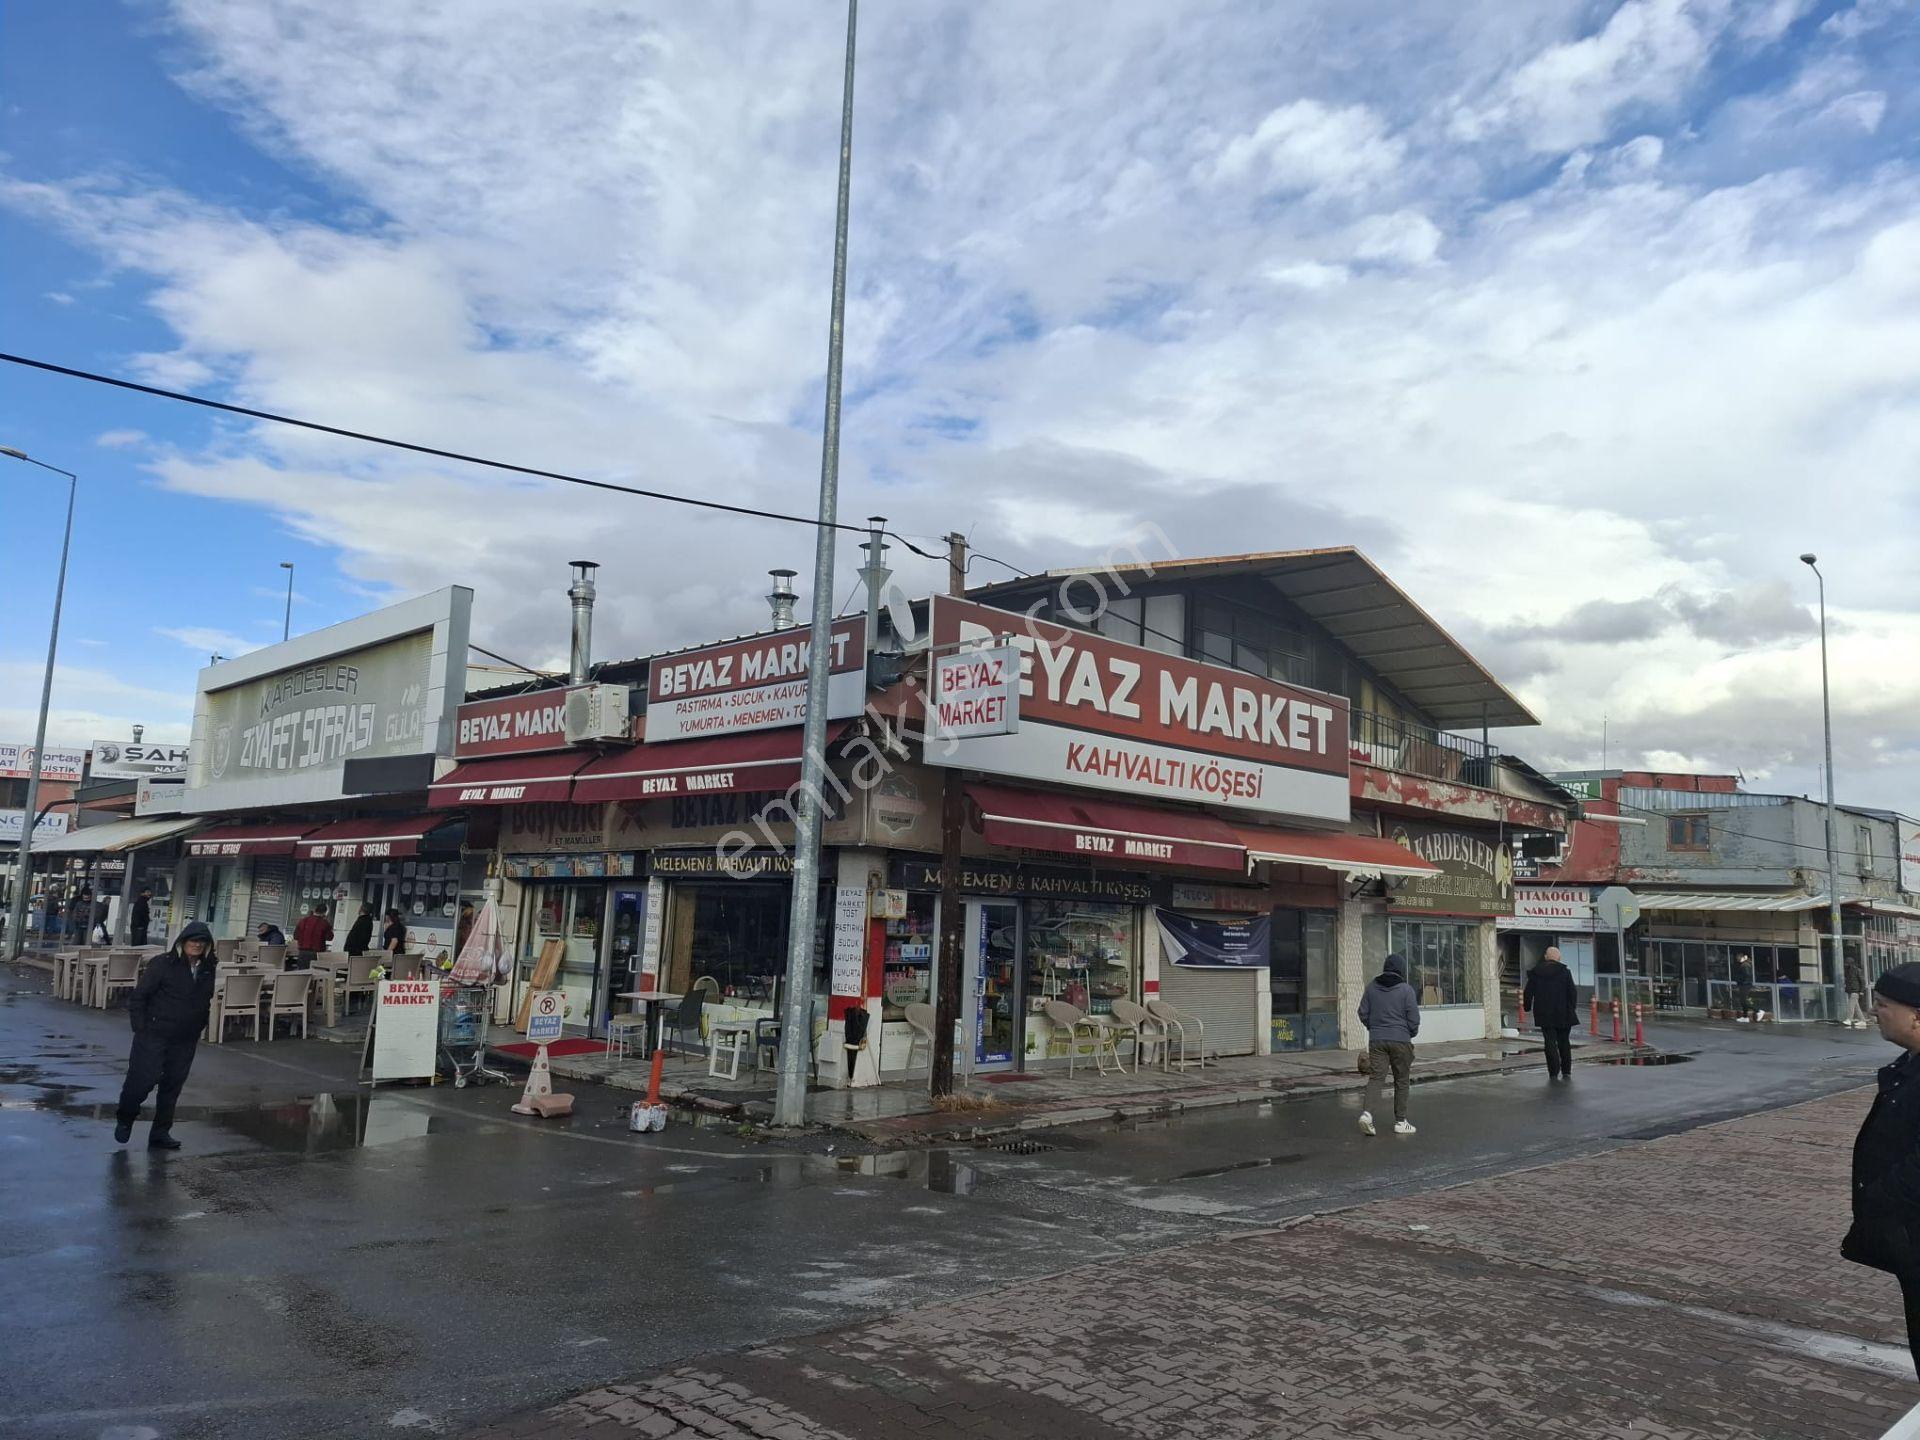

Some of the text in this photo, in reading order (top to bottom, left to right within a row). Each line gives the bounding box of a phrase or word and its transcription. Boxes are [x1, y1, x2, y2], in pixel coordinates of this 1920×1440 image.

[659, 632, 850, 696] BEYAZ MARKT
[943, 660, 1003, 692] BEYAZ
[676, 683, 808, 715] PASTIRMA SUCUK KAVUR
[938, 696, 1006, 727] MARKET
[460, 704, 566, 744] BEYAZ MARK
[680, 704, 808, 732] YUMURTA MENEMEN TO
[1160, 671, 1332, 754] MARKET
[299, 704, 376, 768] SOFRASI
[29, 764, 77, 774] LJİSTİK
[1066, 742, 1263, 801] KAHVALTI KÖŞESİ
[459, 786, 526, 801] BEYAZ MARKET
[643, 772, 734, 794] BEYAZ MARKET
[363, 843, 390, 857] SOFRASI
[1076, 834, 1173, 859] BEYAZ MARKET
[1414, 833, 1494, 876] KARDEŞLER
[653, 856, 705, 872] MELEMEN
[716, 856, 771, 872] KAHVALTI
[775, 855, 795, 876] KÖŞ
[840, 889, 863, 897] BEYAZ
[924, 869, 1012, 889] MEMEN
[1031, 877, 1102, 894] KAHVALTI
[842, 910, 859, 918] TOST
[1524, 905, 1573, 916] NAKLİYAT
[382, 995, 434, 1005] MARKET
[389, 983, 429, 994] BEYAZ
